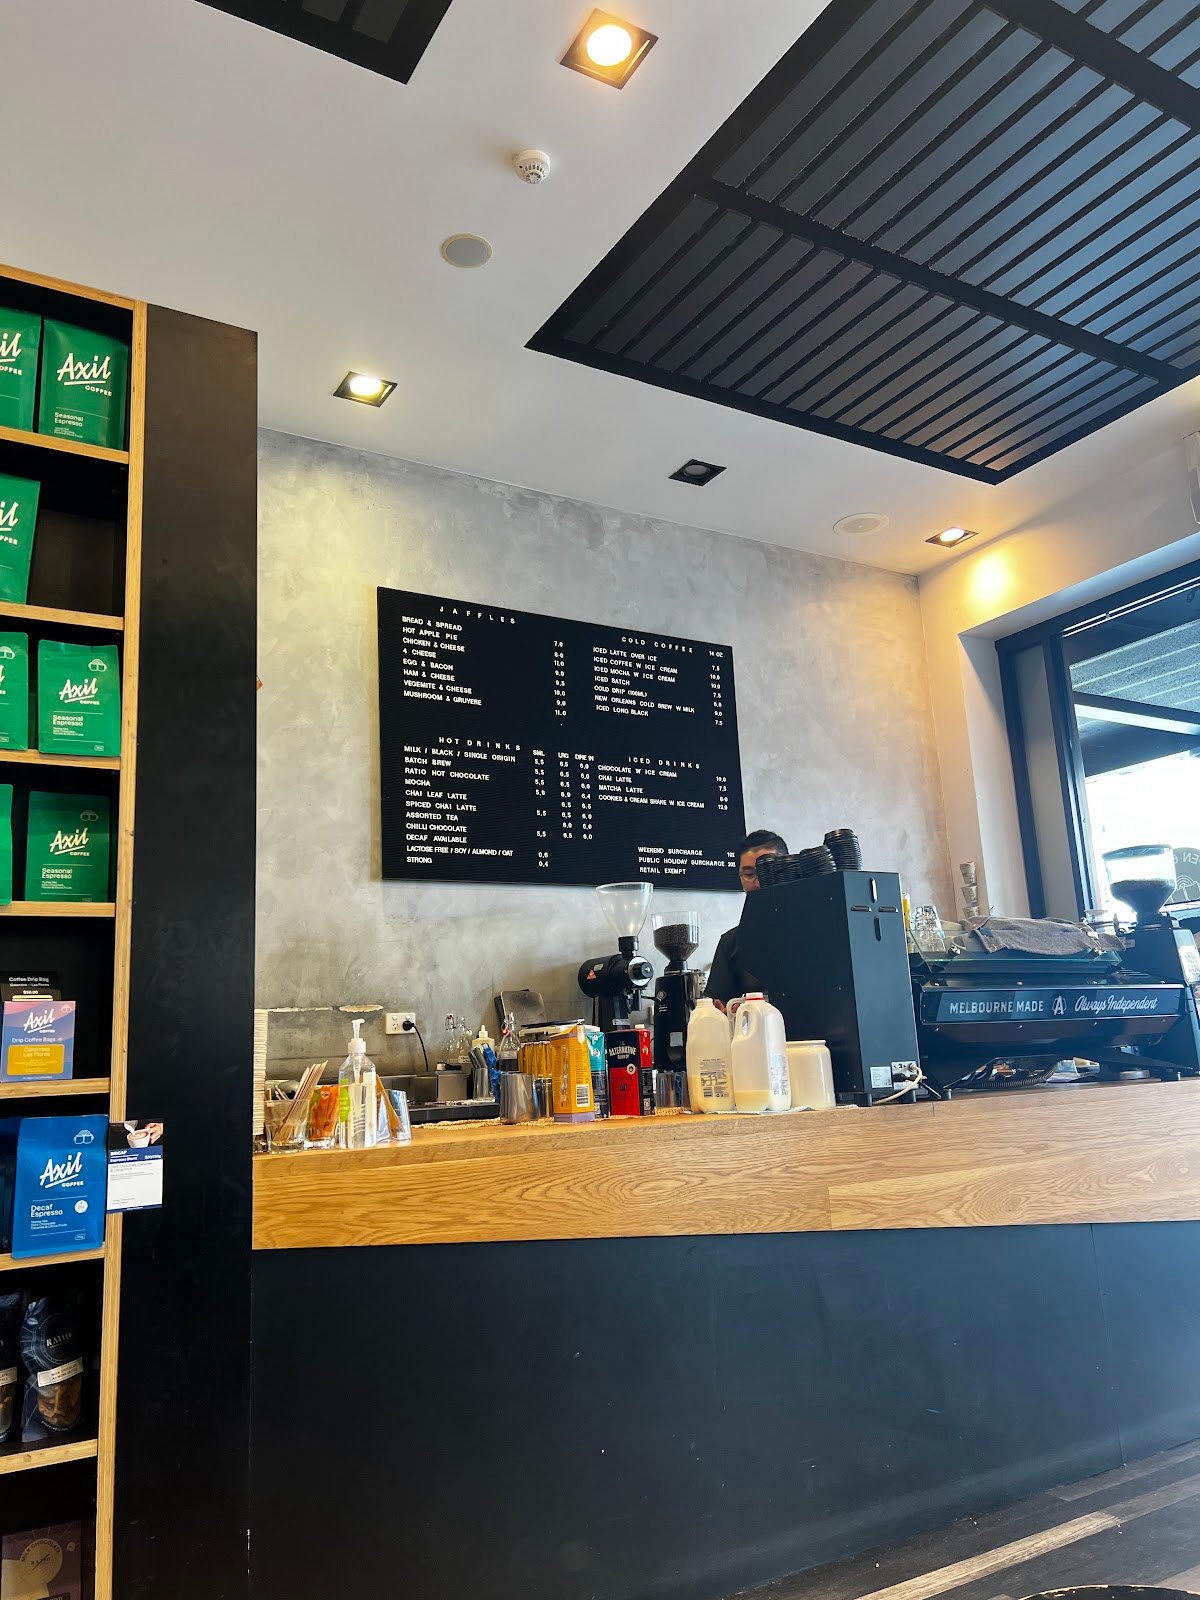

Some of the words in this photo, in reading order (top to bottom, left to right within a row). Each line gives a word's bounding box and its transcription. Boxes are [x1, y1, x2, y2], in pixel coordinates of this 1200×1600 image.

[57, 353, 111, 381] Axil
[85, 385, 112, 396] COFFEE
[54, 412, 84, 422] Seasonal
[54, 418, 83, 427] Espresso
[440, 606, 515, 624] JAFFLES
[402, 616, 424, 625] BREAD
[435, 621, 462, 631] SPREAD
[419, 629, 440, 638] APPLE
[402, 637, 431, 647] CHICKEN
[440, 642, 465, 652] CHEESE
[621, 636, 645, 645] COLD
[654, 642, 692, 653] COFFEE
[412, 648, 436, 658] CHEESE
[609, 649, 627, 657] LATTE
[430, 662, 453, 671] BACON
[609, 659, 632, 667] COFFEE
[430, 672, 455, 682] CHEESE
[610, 668, 630, 676] MOCHA
[403, 679, 436, 689] VEGEMITE
[446, 685, 472, 694] CHEESE
[611, 678, 630, 686] BATCH
[59, 678, 98, 700] Axil
[404, 690, 443, 700] MUSHROOM
[452, 696, 482, 706] GRUYERE
[611, 697, 636, 705] ORLEANS
[467, 740, 520, 750] DRINKS
[404, 756, 427, 764] BATCH
[431, 748, 453, 756] BLACK
[464, 751, 487, 760] SINGLE
[491, 754, 515, 762] ORIGIN
[598, 764, 631, 774] CHOCOLATE
[658, 759, 700, 769] DRINKS
[404, 767, 426, 775] RATIO
[449, 771, 489, 780] CHOCOLATE
[404, 778, 431, 786] MOCHA
[405, 800, 431, 808] SPICED
[406, 812, 442, 820] ASSORTED
[428, 824, 467, 832] CHOCOLATE
[49, 828, 89, 852] Axil
[433, 835, 467, 843] AVAILABLE
[950, 1002, 1013, 1014] MELBOURNE
[1016, 1000, 1044, 1012] MADE
[1074, 996, 1107, 1014] Always
[1106, 995, 1158, 1013] Independent
[23, 1008, 54, 1031] Axil
[39, 1152, 82, 1185] Axil
[31, 1210, 63, 1218] Espresso
